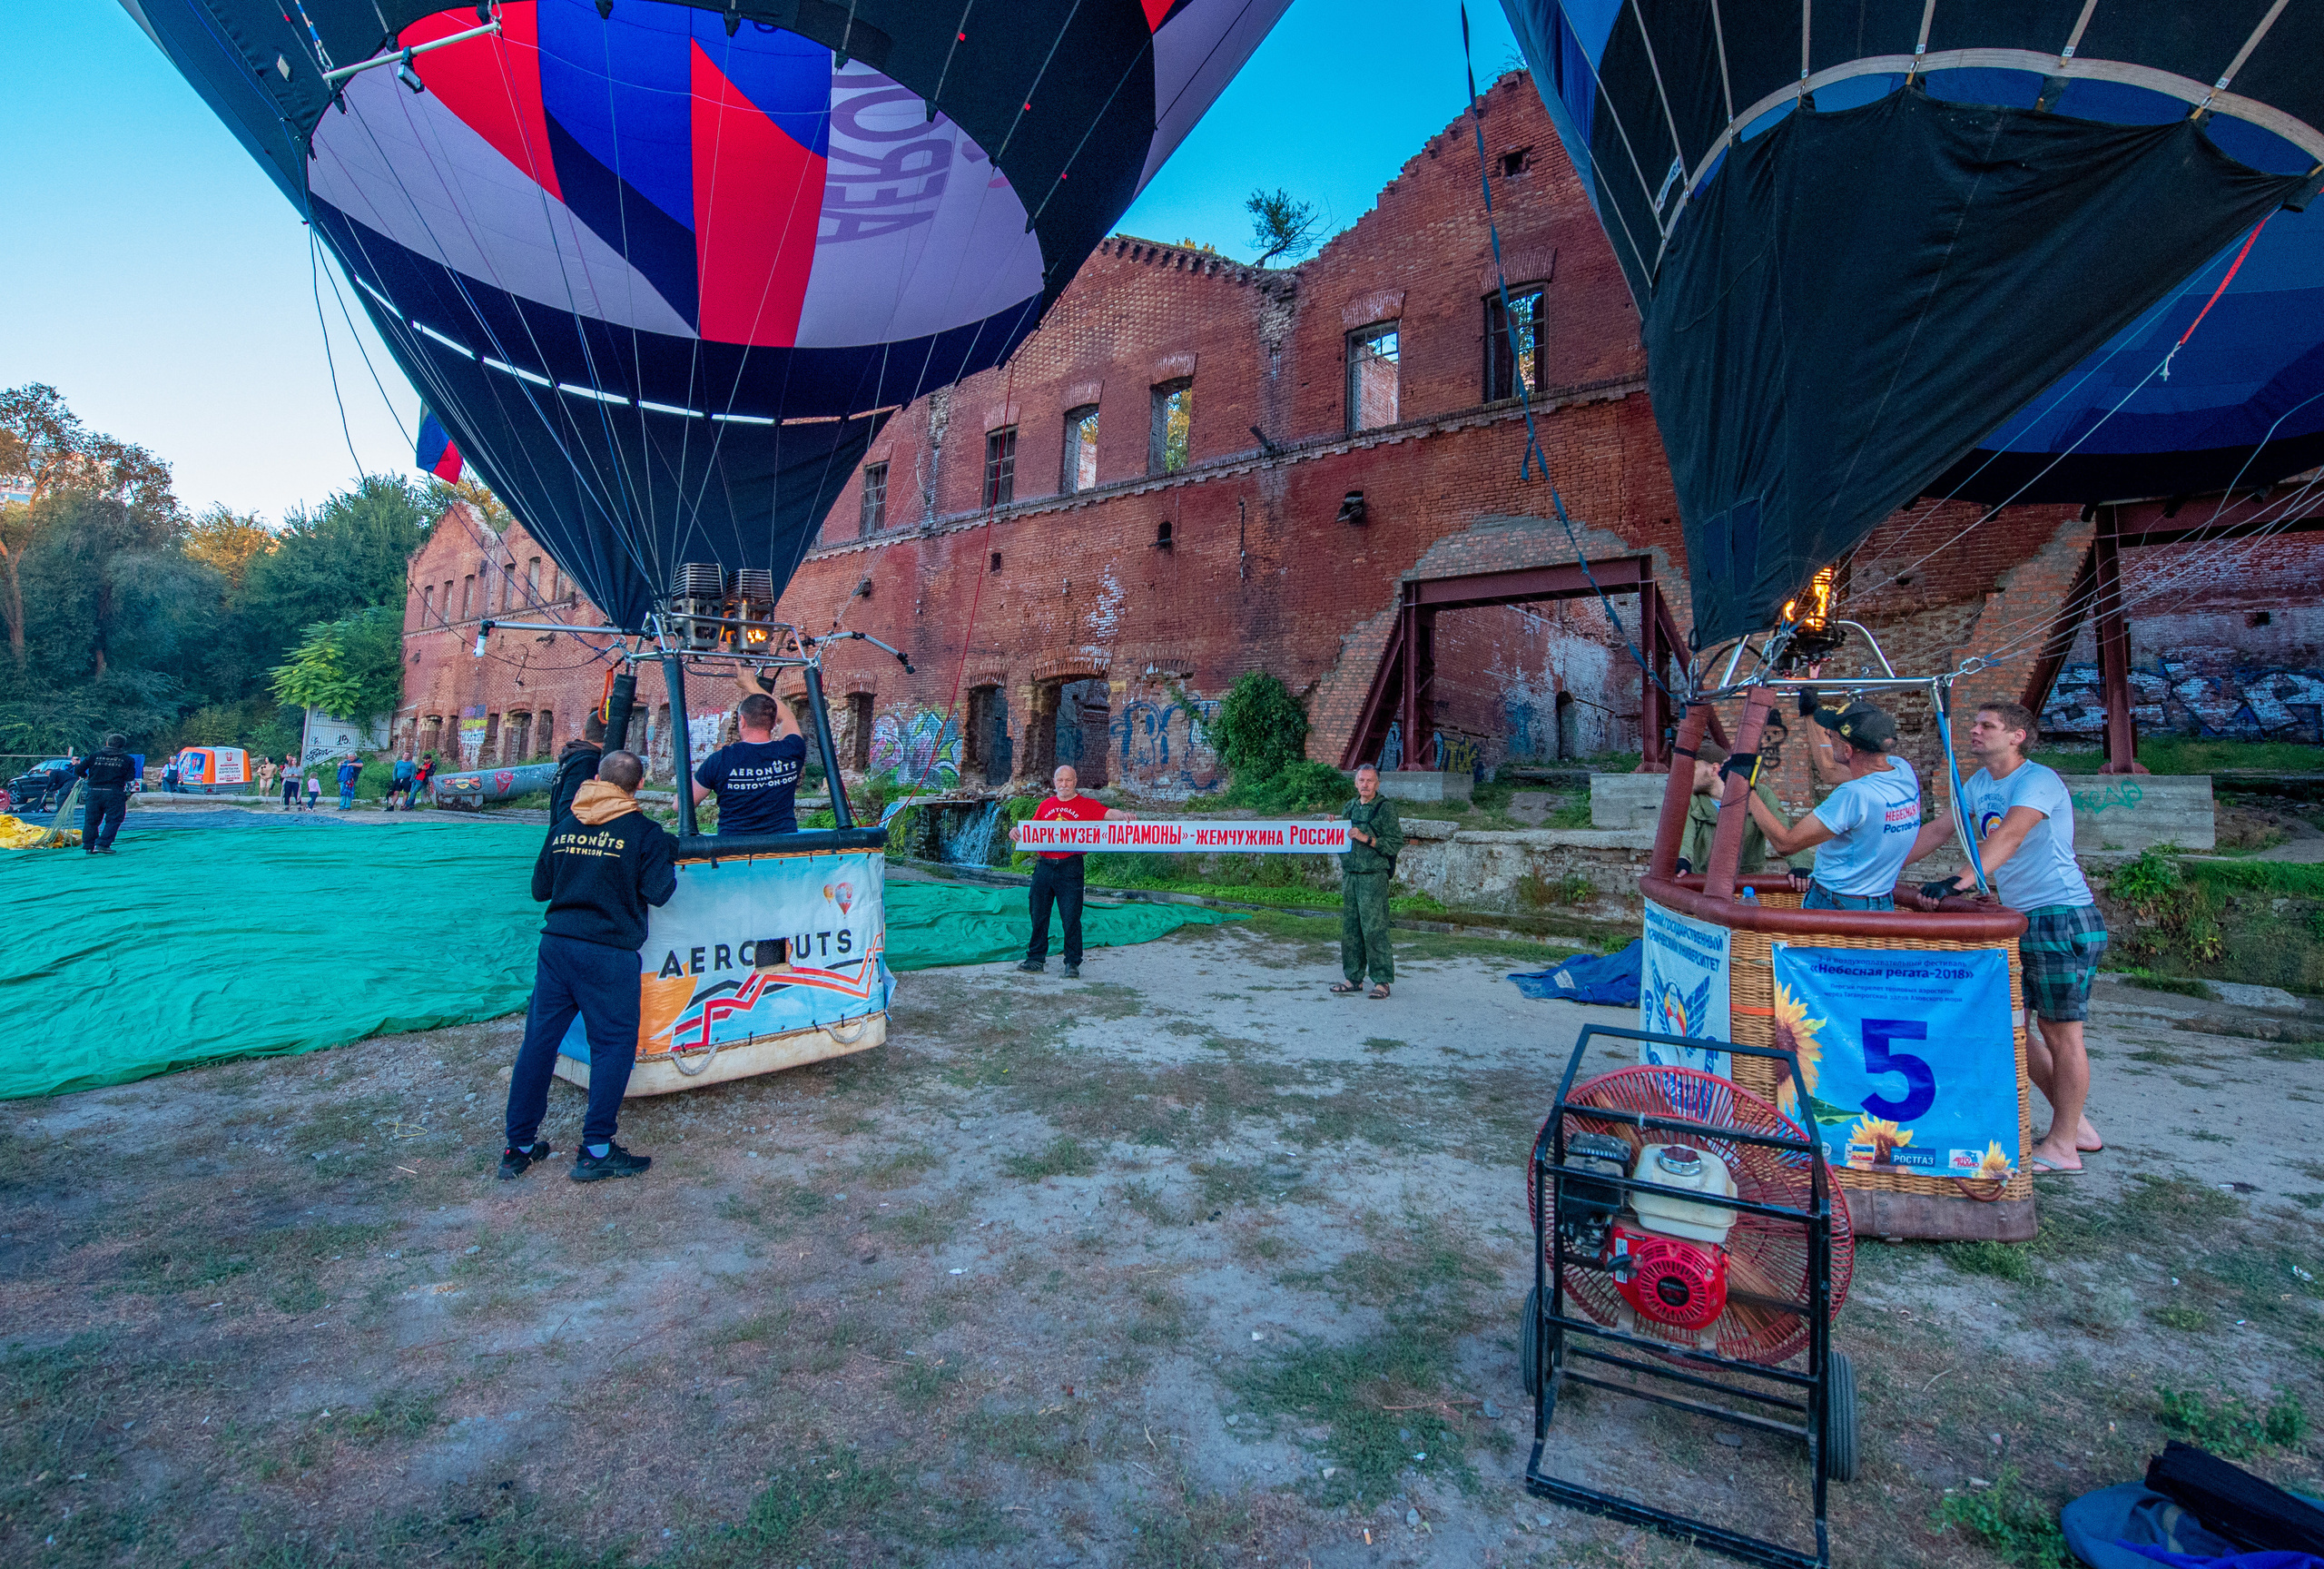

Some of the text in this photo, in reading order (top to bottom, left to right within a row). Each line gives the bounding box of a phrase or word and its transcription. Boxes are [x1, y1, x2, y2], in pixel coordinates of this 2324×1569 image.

[2063, 47, 2073, 55] 22
[729, 760, 797, 776] AERONUTS
[727, 775, 798, 790] ROSTOV-ON-DON
[552, 832, 625, 850] AERONUTS
[565, 846, 602, 856] JETHIGH
[658, 929, 852, 979] AEROUTS
[1809, 963, 1974, 980] «Небесная регата-2018»
[1860, 1018, 1936, 1122] 5
[1893, 1154, 1935, 1165] РОСТГАЗ
